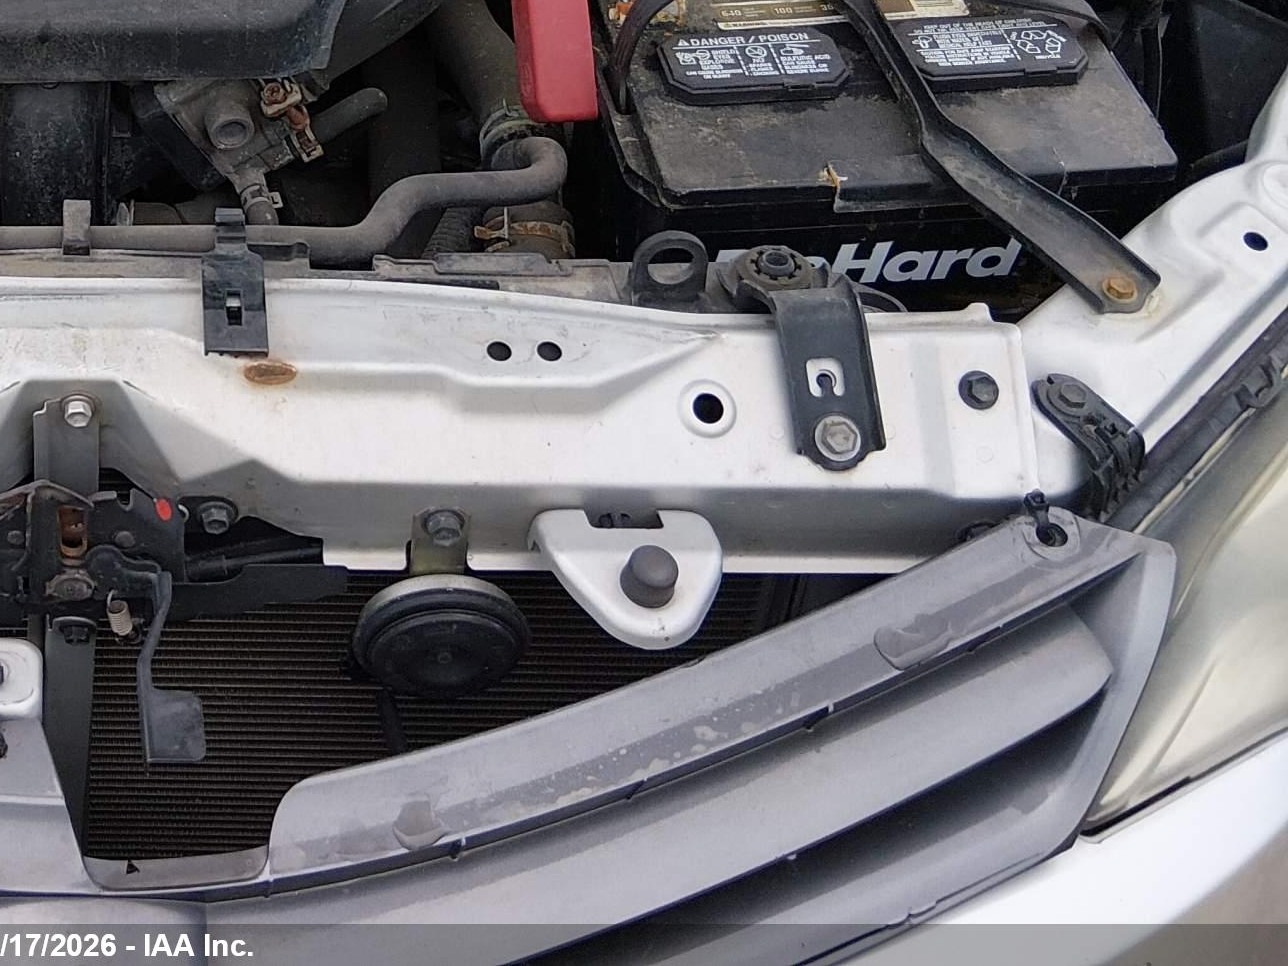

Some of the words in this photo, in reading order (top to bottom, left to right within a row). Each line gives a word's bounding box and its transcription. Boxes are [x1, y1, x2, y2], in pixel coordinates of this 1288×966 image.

[690, 35, 746, 46] DANGER
[759, 32, 810, 42] POISON
[715, 239, 1022, 283] Hard
